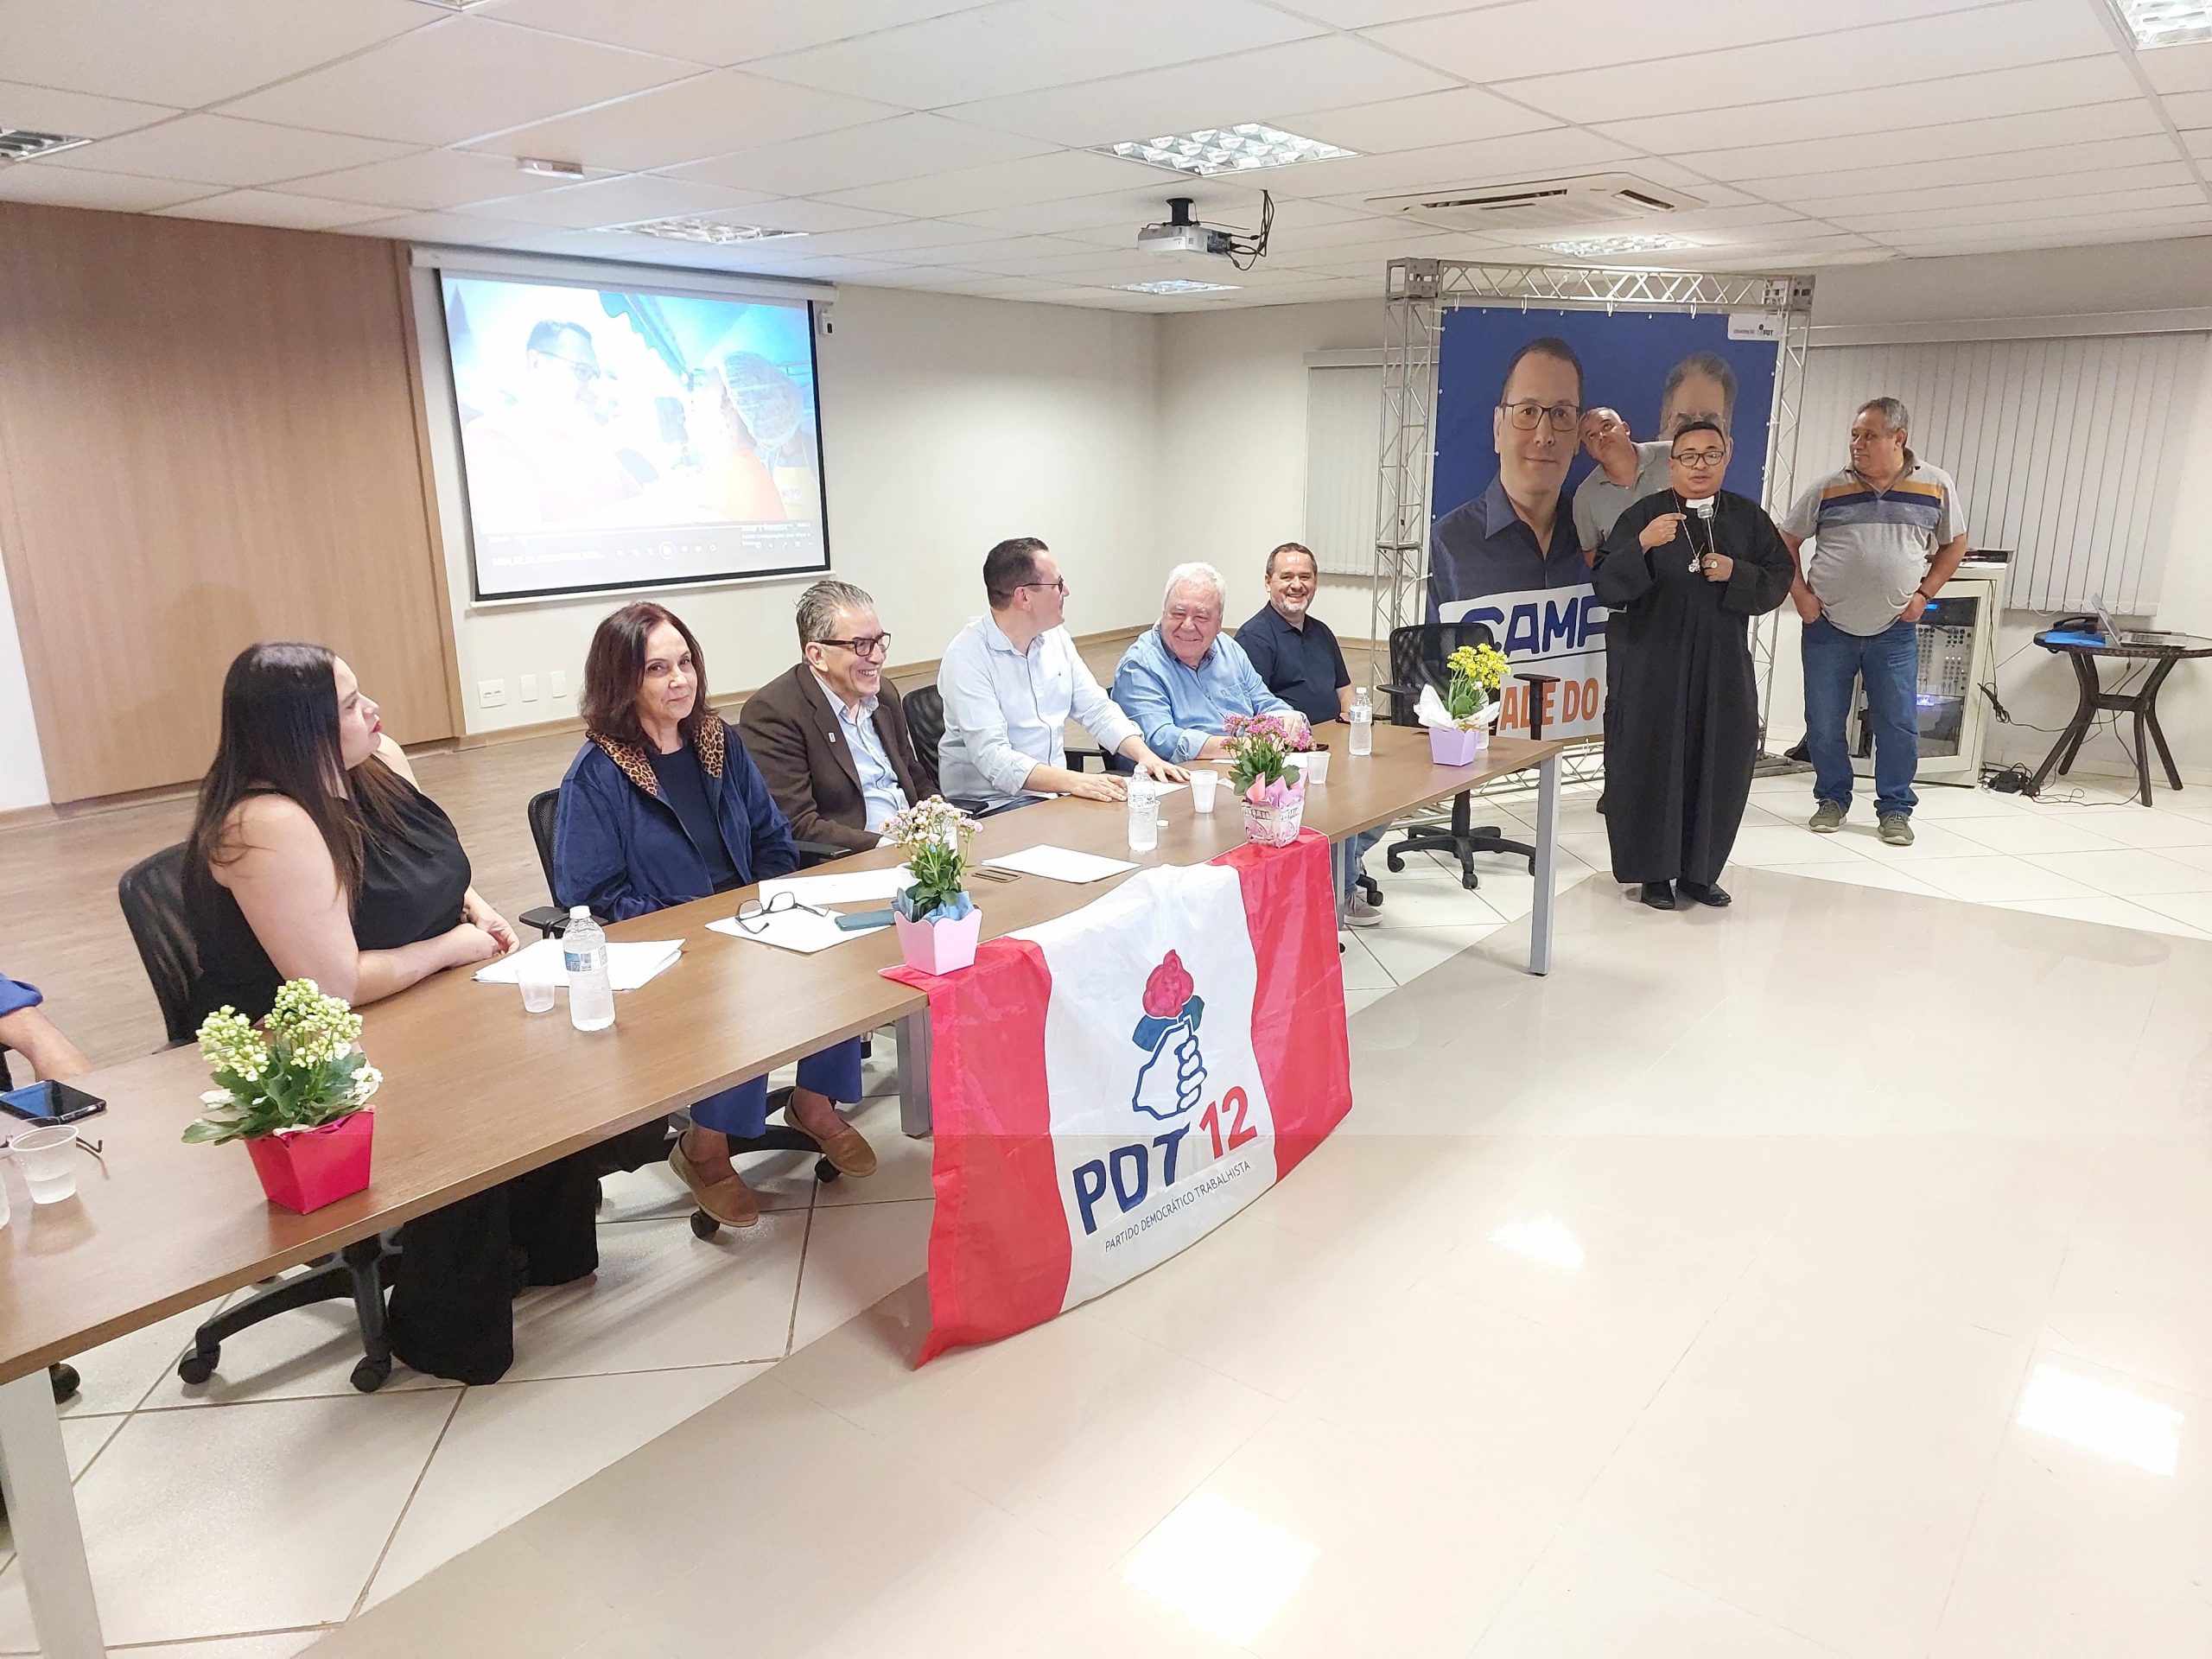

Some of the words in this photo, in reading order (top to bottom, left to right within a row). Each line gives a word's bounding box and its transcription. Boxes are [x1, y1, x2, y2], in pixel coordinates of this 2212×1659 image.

[1561, 677, 1599, 723] DO
[1072, 1121, 1191, 1236] PDT
[1199, 1085, 1258, 1160] 12
[1105, 1224, 1140, 1252] PARTIDO
[1141, 1191, 1195, 1234] DEMOCRÁTICO
[1195, 1160, 1251, 1198] TRABALHISTA
